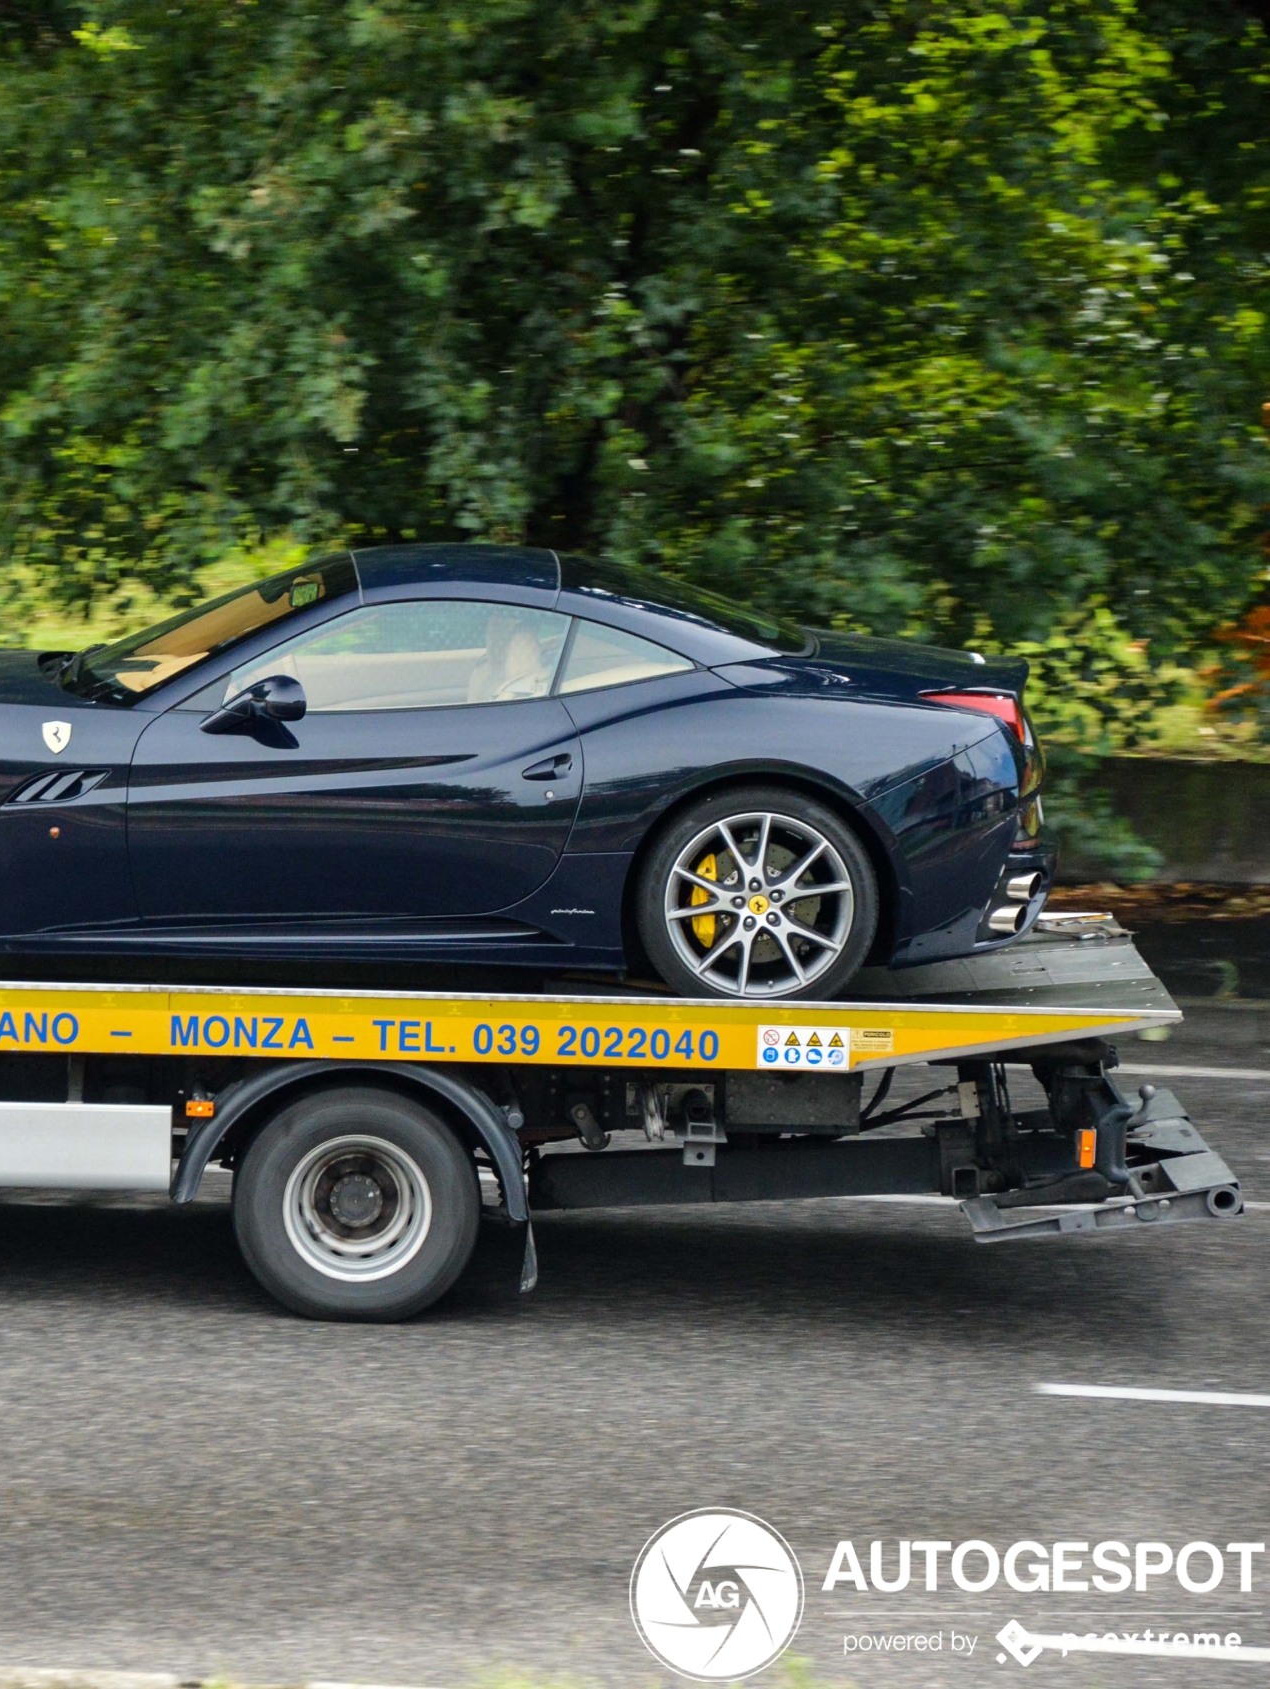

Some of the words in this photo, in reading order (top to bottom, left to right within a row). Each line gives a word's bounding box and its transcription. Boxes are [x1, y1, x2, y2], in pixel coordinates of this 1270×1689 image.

[170, 1015, 314, 1049] MONZA
[372, 1020, 456, 1053] TEL.
[473, 1024, 540, 1056] 039
[557, 1026, 720, 1061] 2022040
